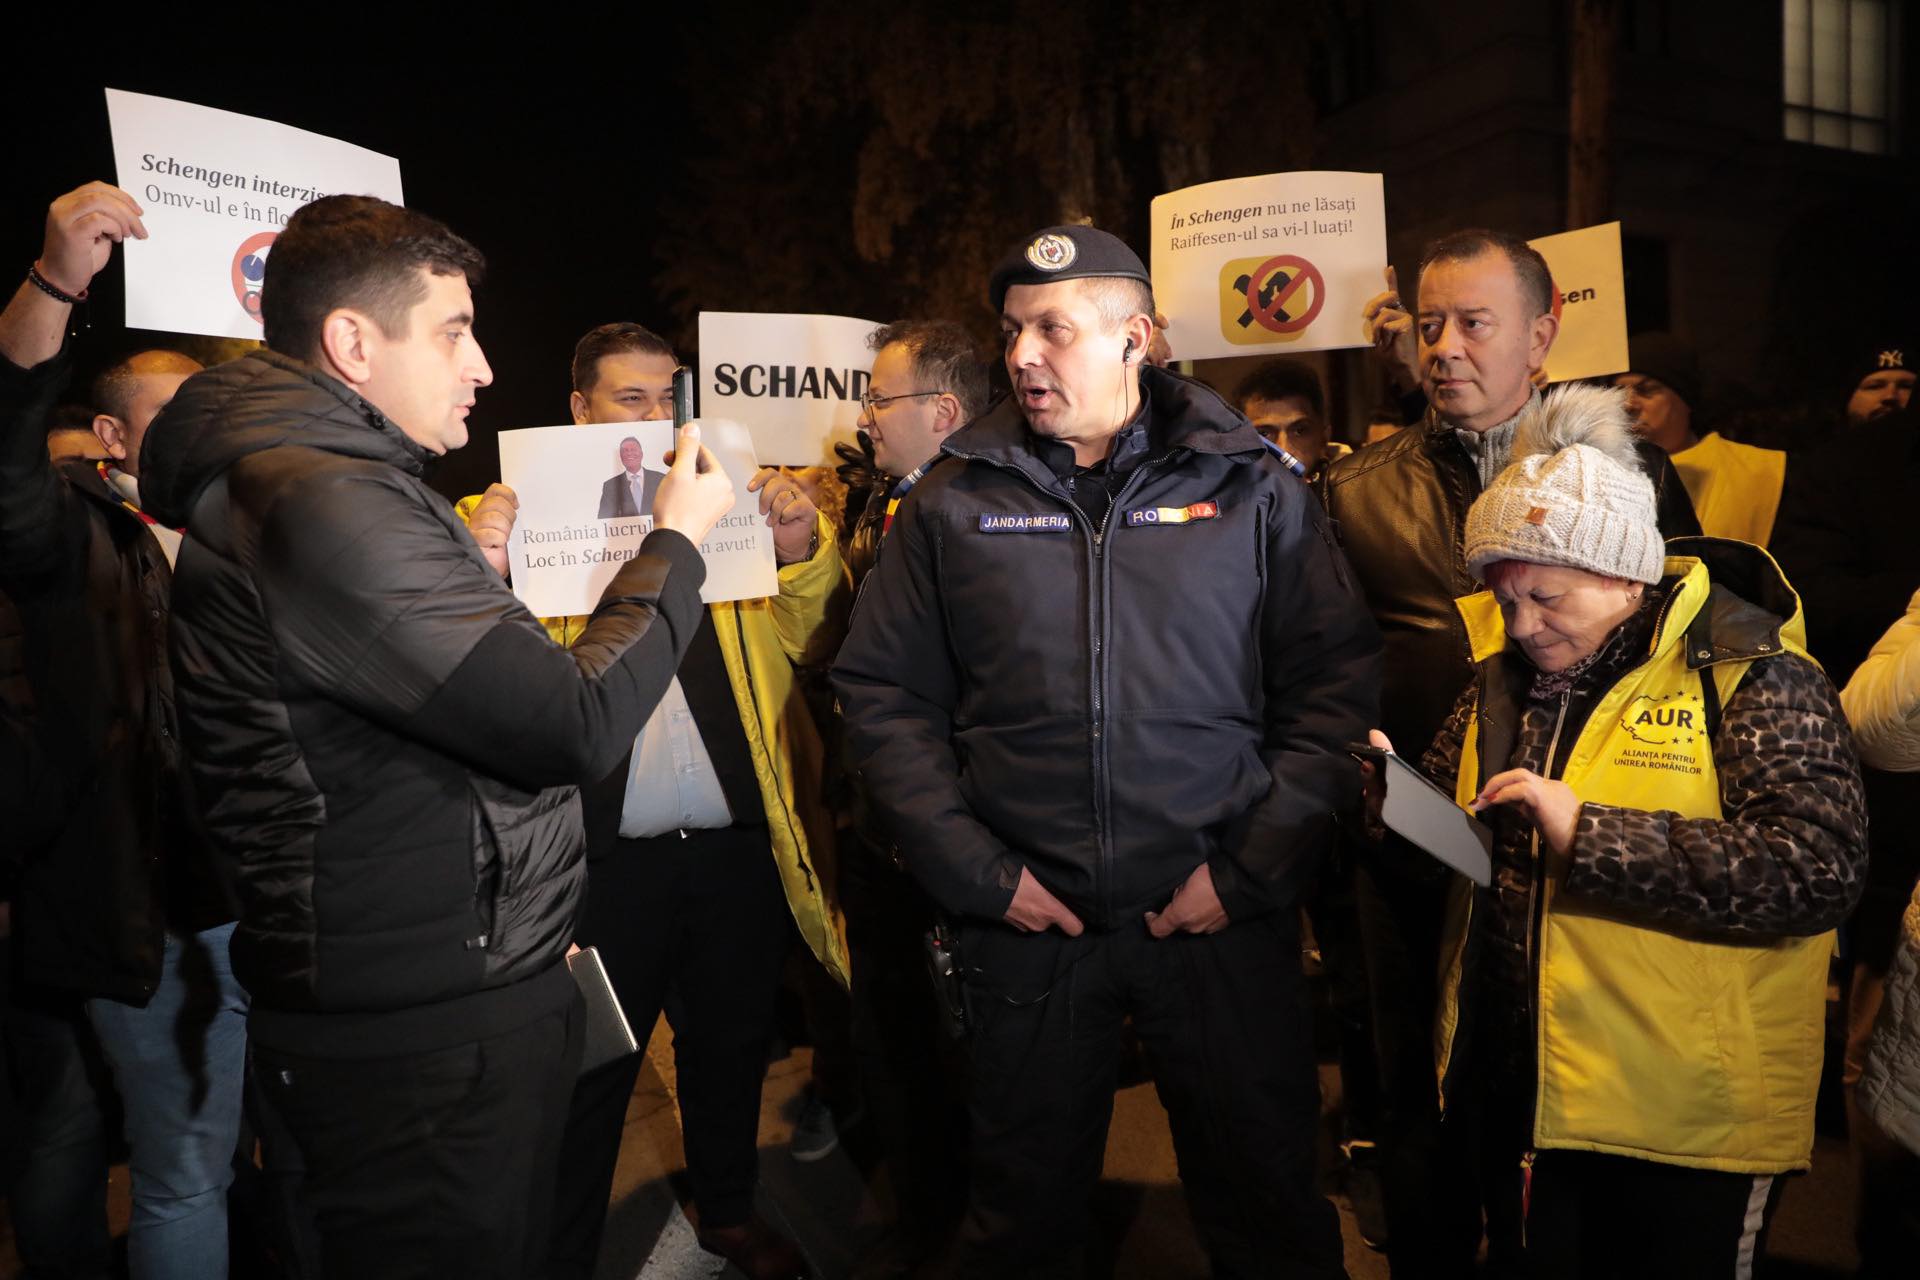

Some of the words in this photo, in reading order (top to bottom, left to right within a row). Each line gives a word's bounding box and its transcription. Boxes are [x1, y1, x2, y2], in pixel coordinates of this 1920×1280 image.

[141, 153, 247, 189] Schengen
[145, 184, 221, 215] Omv-ul
[228, 204, 238, 217] e
[244, 201, 261, 222] în
[268, 206, 289, 226] flo
[1170, 213, 1185, 230] În
[1188, 205, 1262, 226] Schengen
[1267, 203, 1287, 216] nu
[1291, 199, 1311, 213] ne
[1315, 196, 1356, 214] lăsați
[1170, 225, 1257, 251] Raiffesen-ul
[1262, 227, 1278, 238] sa
[1283, 220, 1308, 237] vi-l
[1313, 219, 1353, 238] luați!
[1560, 288, 1596, 305] sen
[714, 363, 871, 402] SCHAND
[984, 516, 1070, 528] JANDARMERIA
[1132, 506, 1214, 523] RONIA
[521, 525, 599, 544] România
[603, 519, 652, 538] lucrul
[525, 553, 556, 569] Loc
[560, 550, 577, 566] în
[582, 547, 640, 564] Schen
[715, 535, 756, 553] avut!
[1635, 708, 1694, 730] AUR
[1614, 758, 1646, 768] UNIREA
[1648, 761, 1702, 775] ROMÂNILOR
[1622, 748, 1659, 761] ALIANȚA
[1661, 752, 1696, 764] PENTRU
